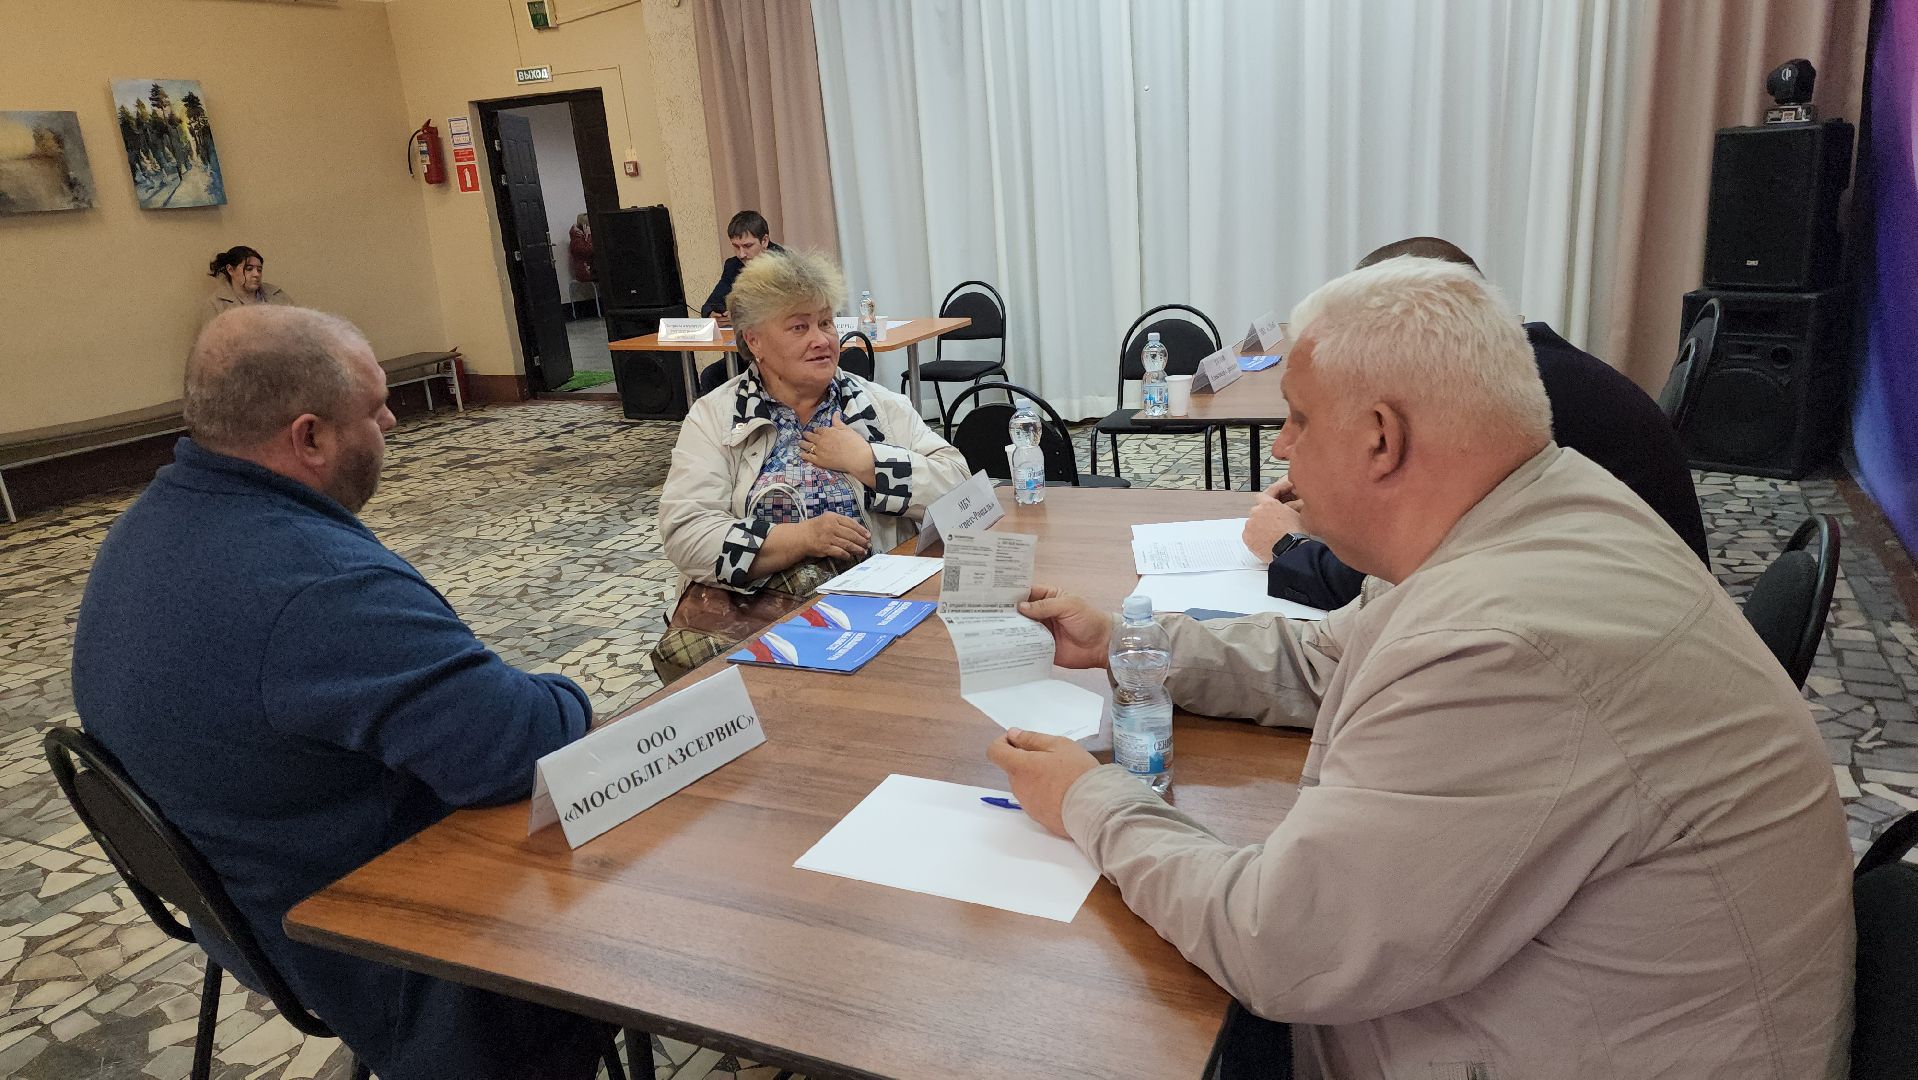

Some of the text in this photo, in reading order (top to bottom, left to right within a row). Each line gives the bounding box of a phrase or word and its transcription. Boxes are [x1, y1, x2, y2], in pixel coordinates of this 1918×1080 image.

[518, 68, 549, 80] ВЫХОД
[636, 725, 677, 755] ООО
[563, 714, 755, 823] «МОСОБЛГАЗСЕРВИС»
